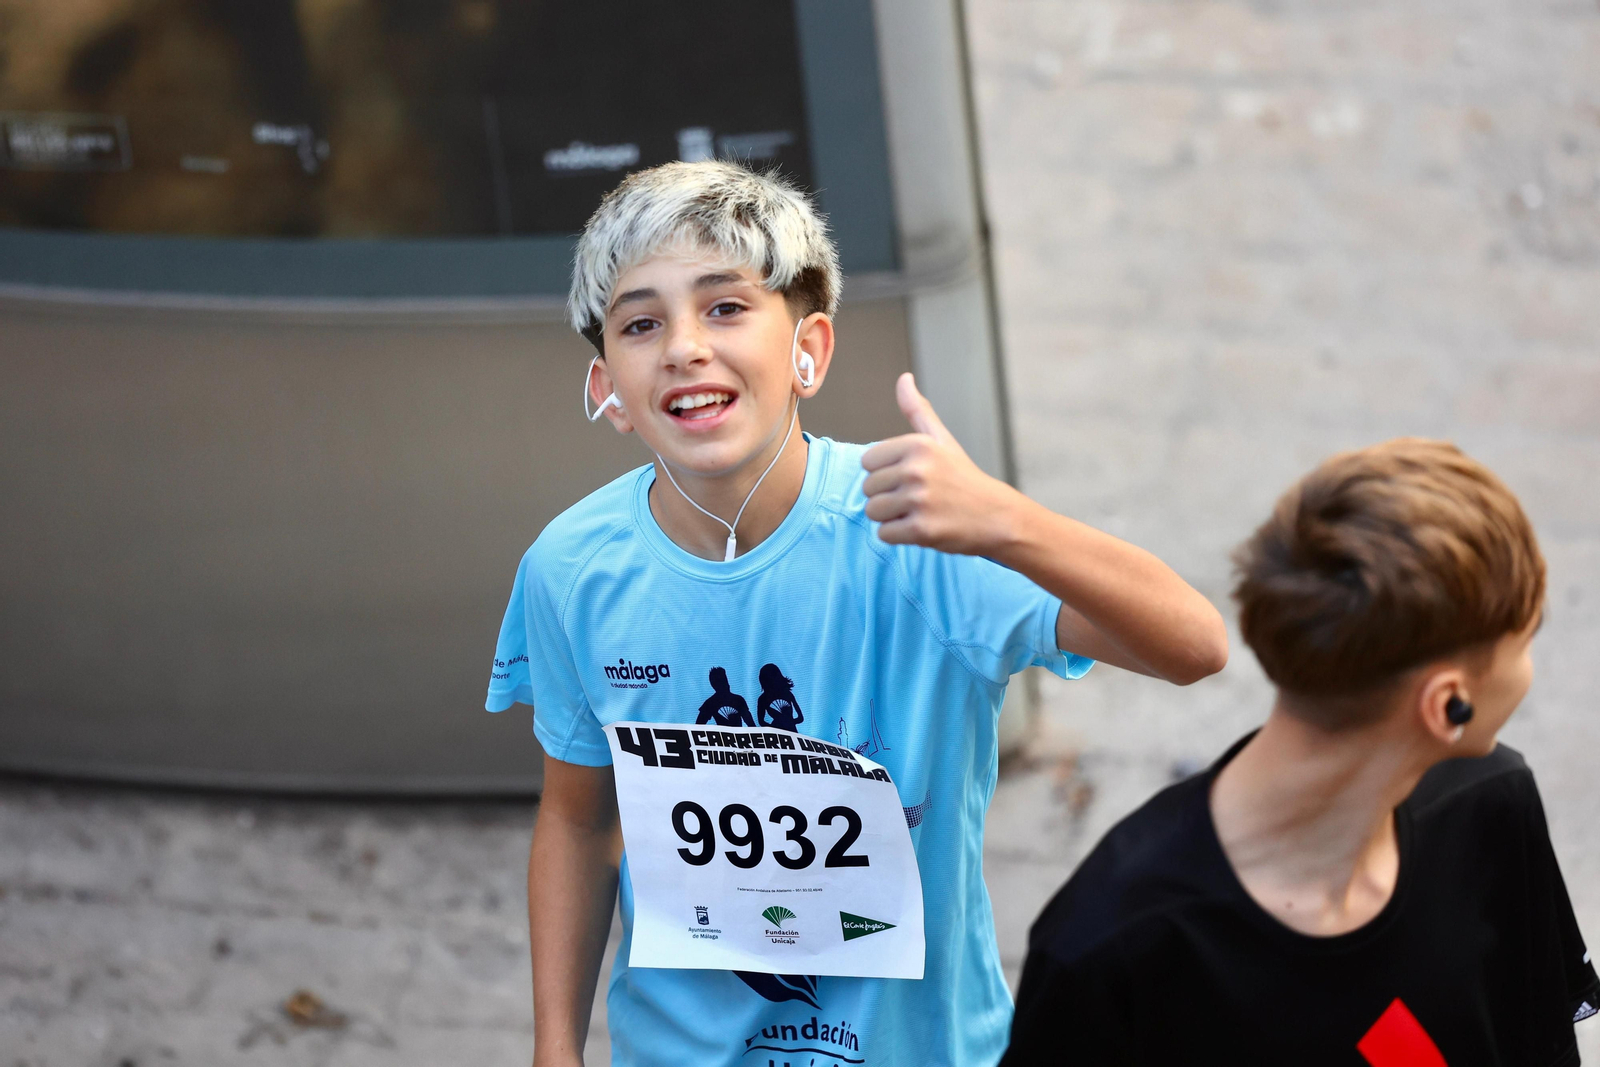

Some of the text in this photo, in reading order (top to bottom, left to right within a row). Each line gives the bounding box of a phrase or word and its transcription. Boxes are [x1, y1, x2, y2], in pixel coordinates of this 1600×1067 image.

[615, 727, 696, 770] 43
[691, 730, 856, 760] CARRERA URBA
[696, 748, 762, 767] CIUDAD
[764, 753, 778, 763] DE
[671, 801, 870, 870] 9932
[843, 921, 850, 929] El
